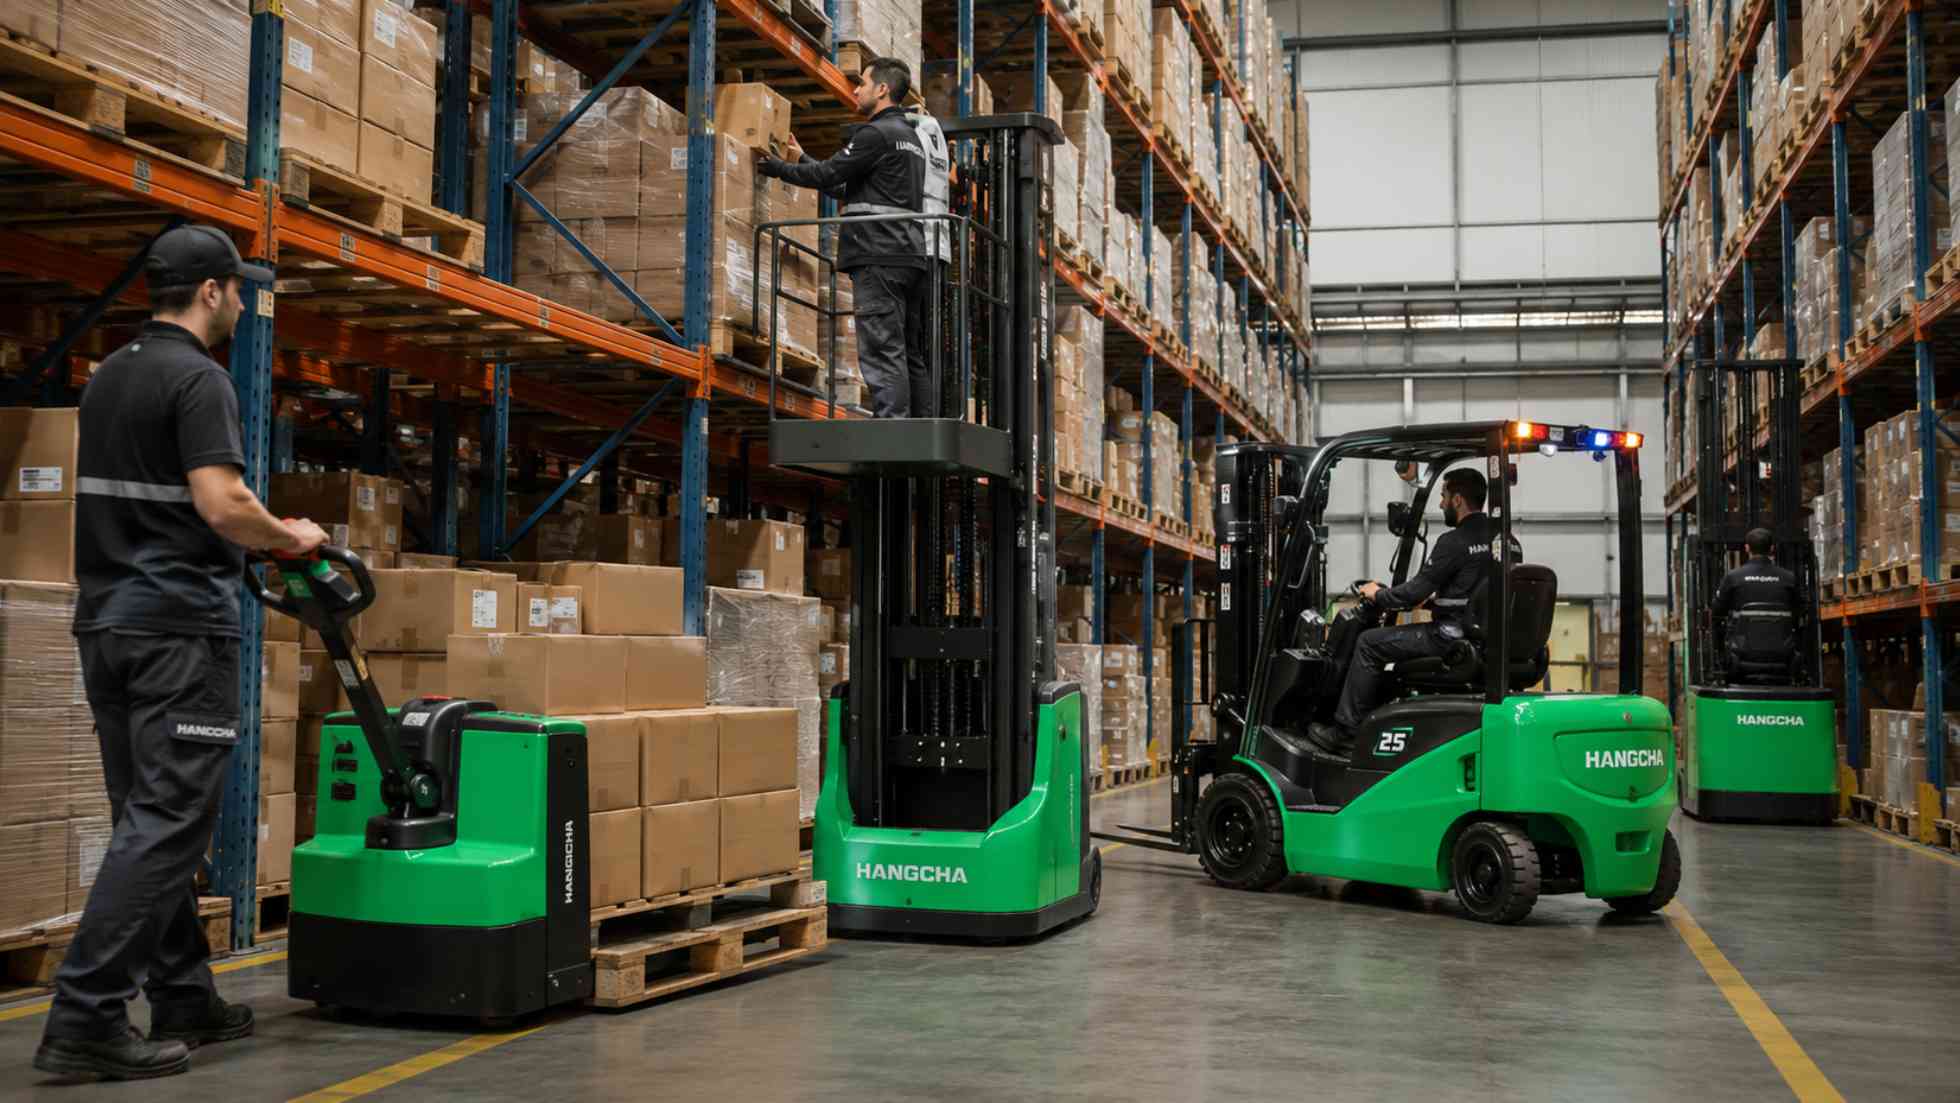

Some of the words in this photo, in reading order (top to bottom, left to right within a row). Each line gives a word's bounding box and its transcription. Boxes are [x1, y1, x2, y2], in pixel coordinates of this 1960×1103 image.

[1737, 714, 1805, 726] HANGCHA
[1379, 731, 1406, 752] 25
[1585, 749, 1664, 769] HANGCHA
[856, 862, 968, 884] HANGCHA
